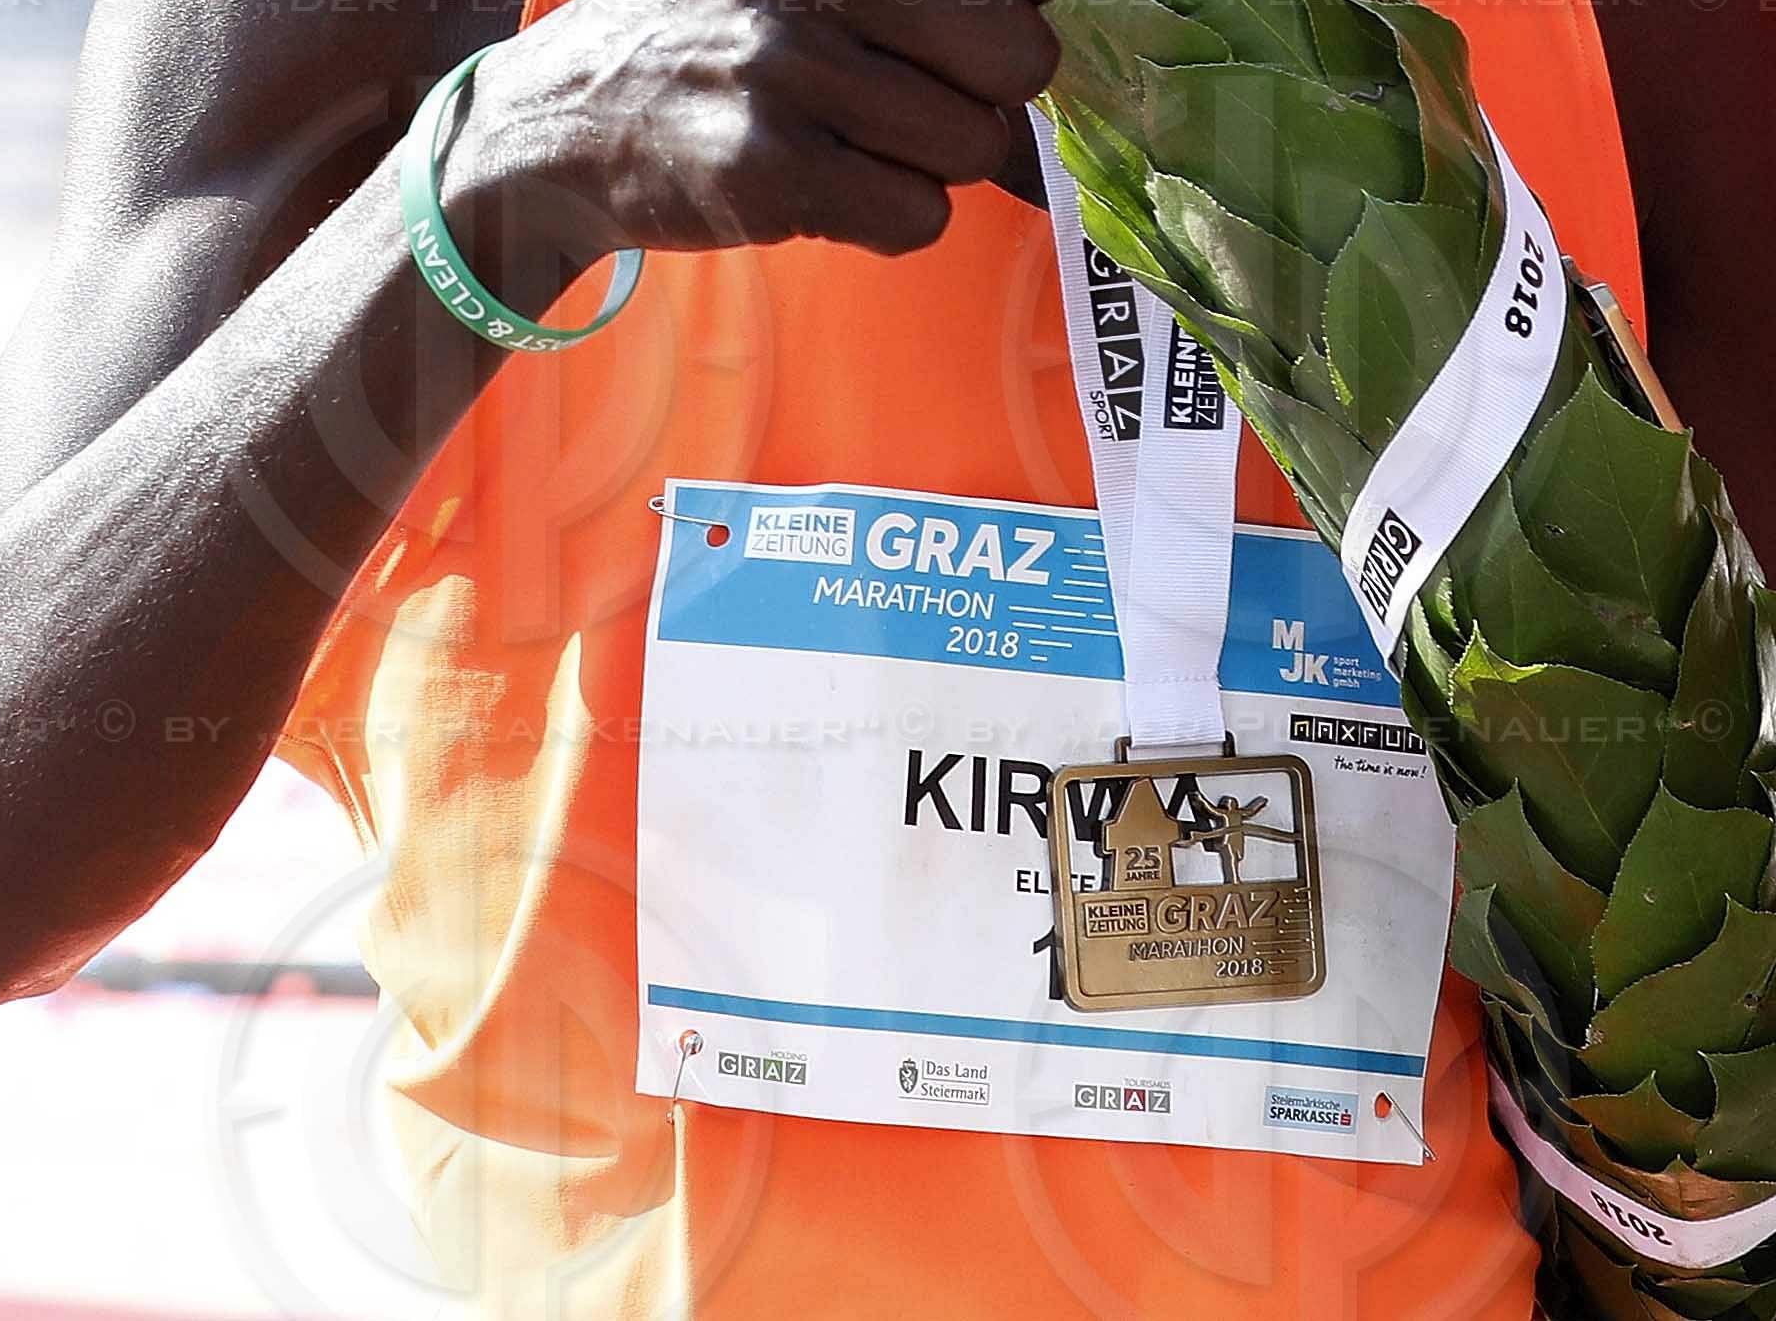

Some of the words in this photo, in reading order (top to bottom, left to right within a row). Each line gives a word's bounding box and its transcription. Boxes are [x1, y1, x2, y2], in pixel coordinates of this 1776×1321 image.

[411, 219, 486, 321] CLEAN
[1505, 230, 1546, 339] 2018
[1090, 390, 1116, 442] SPORT
[757, 512, 849, 535] KLEINE
[751, 534, 849, 558] ZEITUNG
[865, 512, 1056, 586] GRAZ
[813, 576, 995, 621] MARATHON
[946, 626, 1020, 659] 2018
[1333, 656, 1360, 668] sport
[1333, 667, 1382, 682] marketing
[1333, 678, 1361, 689] gmbh
[1125, 846, 1162, 871] 25
[1125, 870, 1161, 882] JAHRE
[1089, 904, 1146, 919] KLEINE
[1156, 890, 1280, 934] GRAZ
[1090, 917, 1146, 933] ZEITUNG
[1130, 936, 1244, 961] MARATHON
[1216, 958, 1264, 978] 2018
[720, 1053, 805, 1084] GRAZ
[926, 1060, 951, 1077] Das
[955, 1062, 988, 1080] Land
[920, 1082, 987, 1101] Steiermark
[1076, 1086, 1168, 1112] GRAZ
[1268, 1106, 1340, 1126] SPARKASSE
